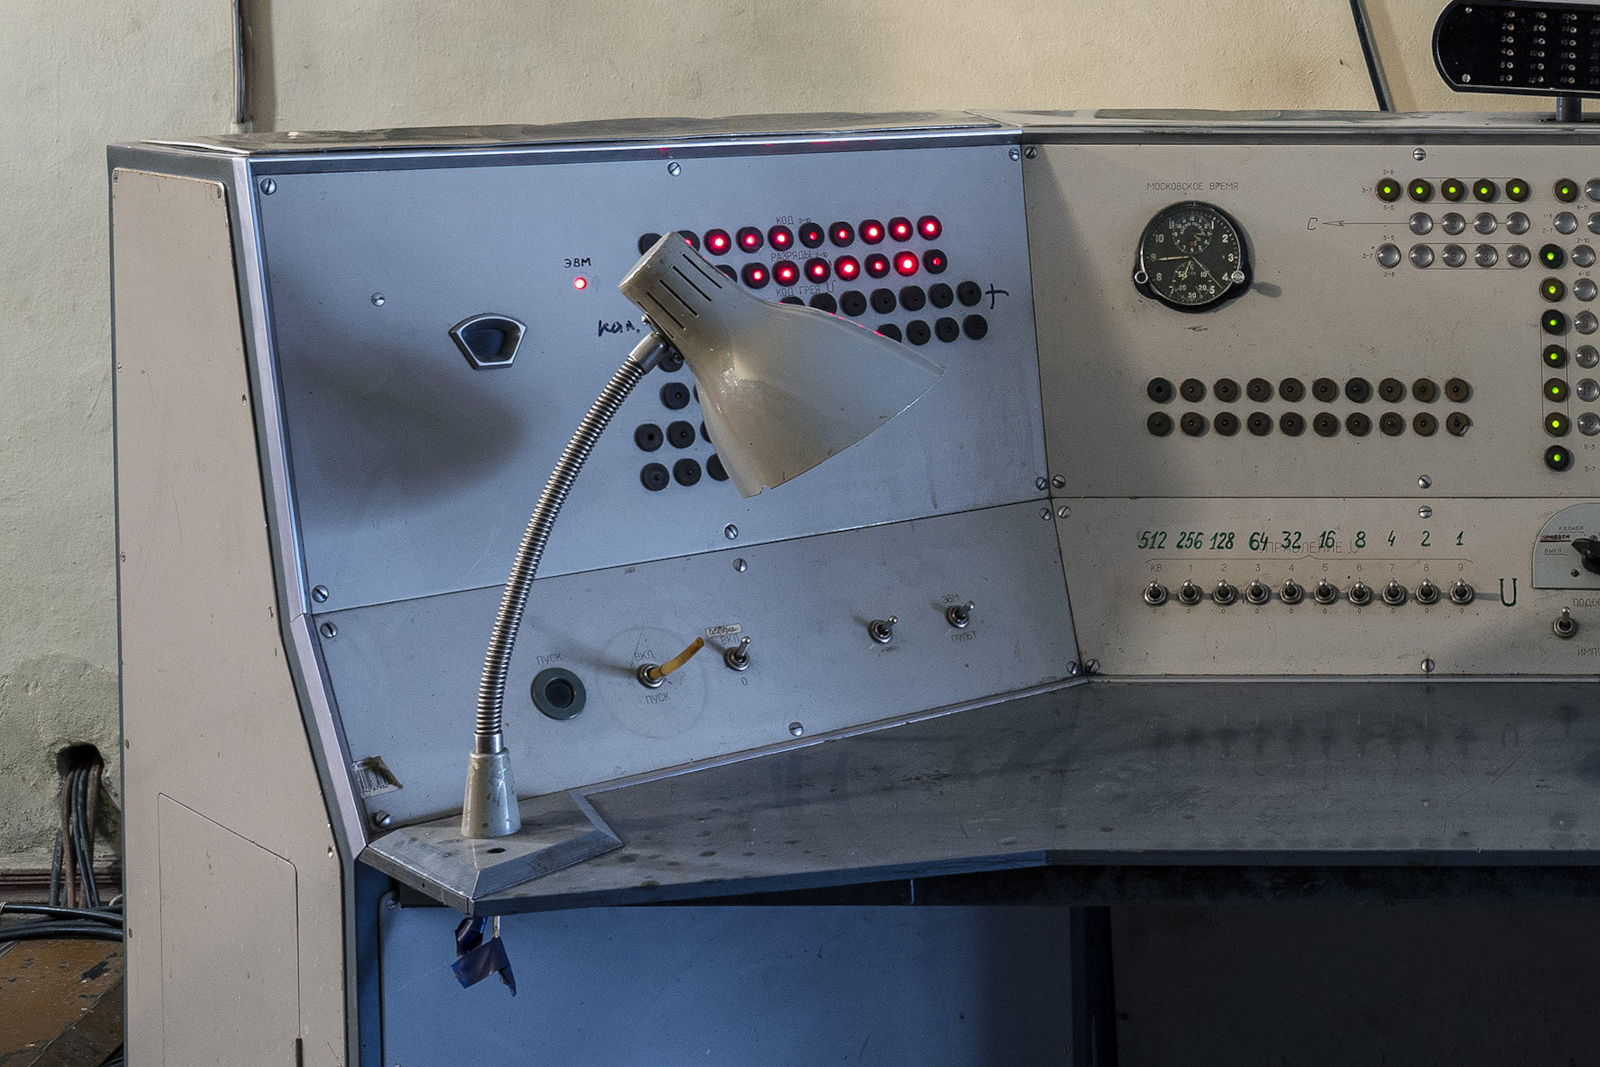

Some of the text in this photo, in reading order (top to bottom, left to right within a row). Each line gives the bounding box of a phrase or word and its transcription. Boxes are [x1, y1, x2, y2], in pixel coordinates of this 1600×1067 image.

[1147, 182, 1239, 191] МОСКОВСКОЕ ВРЕМЯ
[775, 215, 794, 225] КОД
[1222, 234, 1229, 243] 2
[770, 250, 812, 262] РАЗРЯДЫ
[1227, 253, 1234, 262] 3
[563, 257, 592, 268] ЭВМ
[775, 284, 821, 297] КОД ГРЕЯ
[1137, 530, 1465, 551] 512 256 128 64 32 16 8 4 2 1
[1150, 563, 1464, 572] КВ 3 5 8 9
[1499, 578, 1517, 607] U
[536, 652, 563, 666] ПУСК
[645, 692, 671, 706] ПУСК
